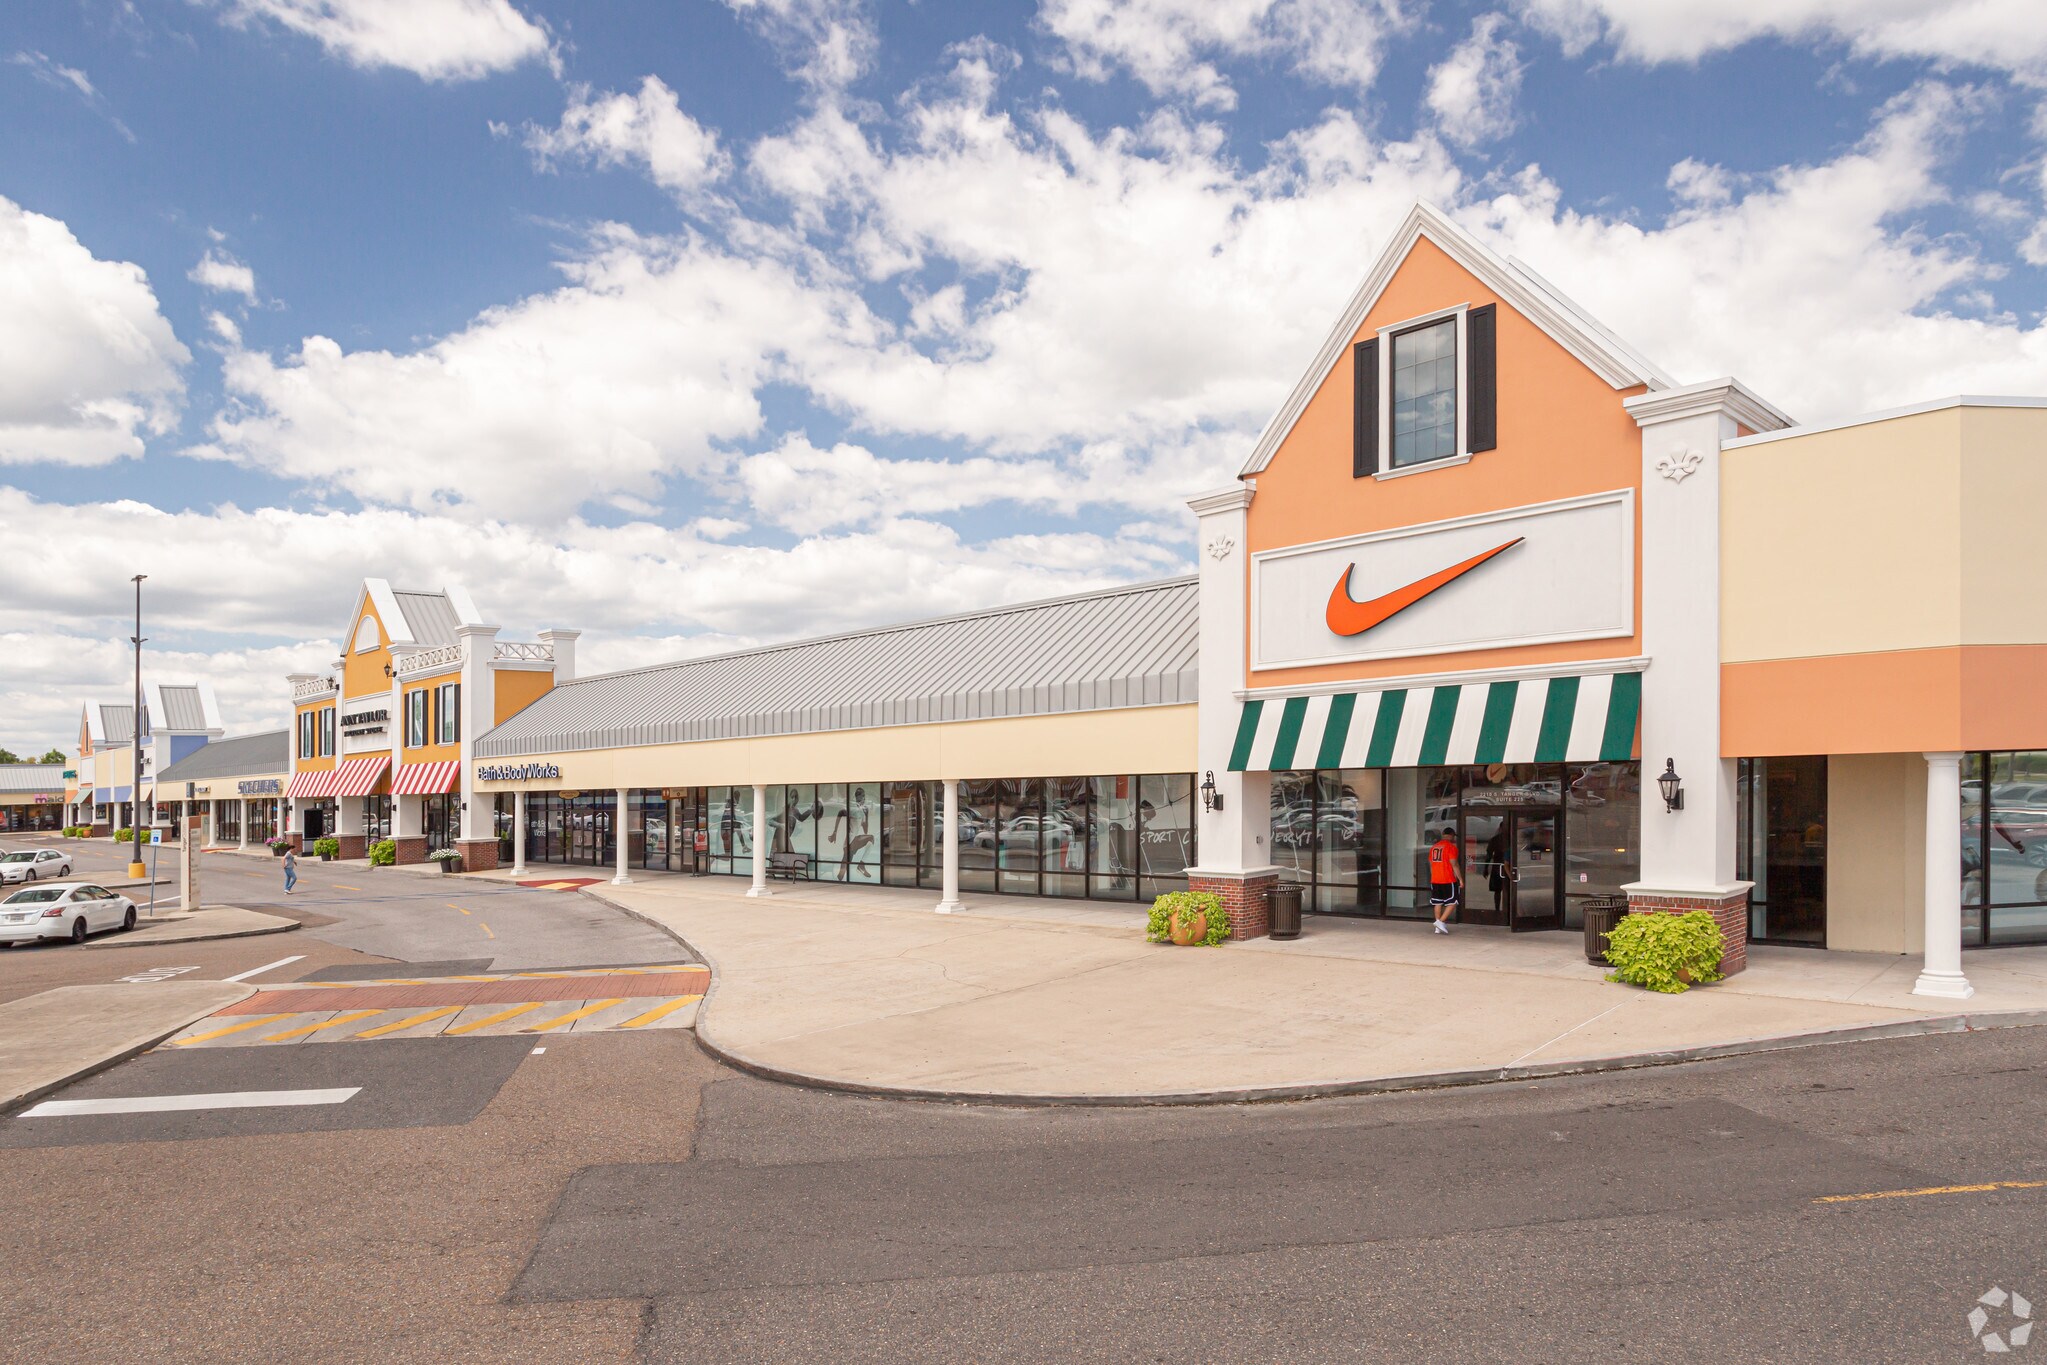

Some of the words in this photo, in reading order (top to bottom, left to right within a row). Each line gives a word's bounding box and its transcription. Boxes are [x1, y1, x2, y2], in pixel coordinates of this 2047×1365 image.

[478, 765, 497, 781] Bath
[497, 765, 505, 780] &
[504, 764, 528, 782] Body
[528, 762, 560, 779] Works
[237, 779, 281, 795] SKECHERS
[1140, 829, 1176, 844] SPORT
